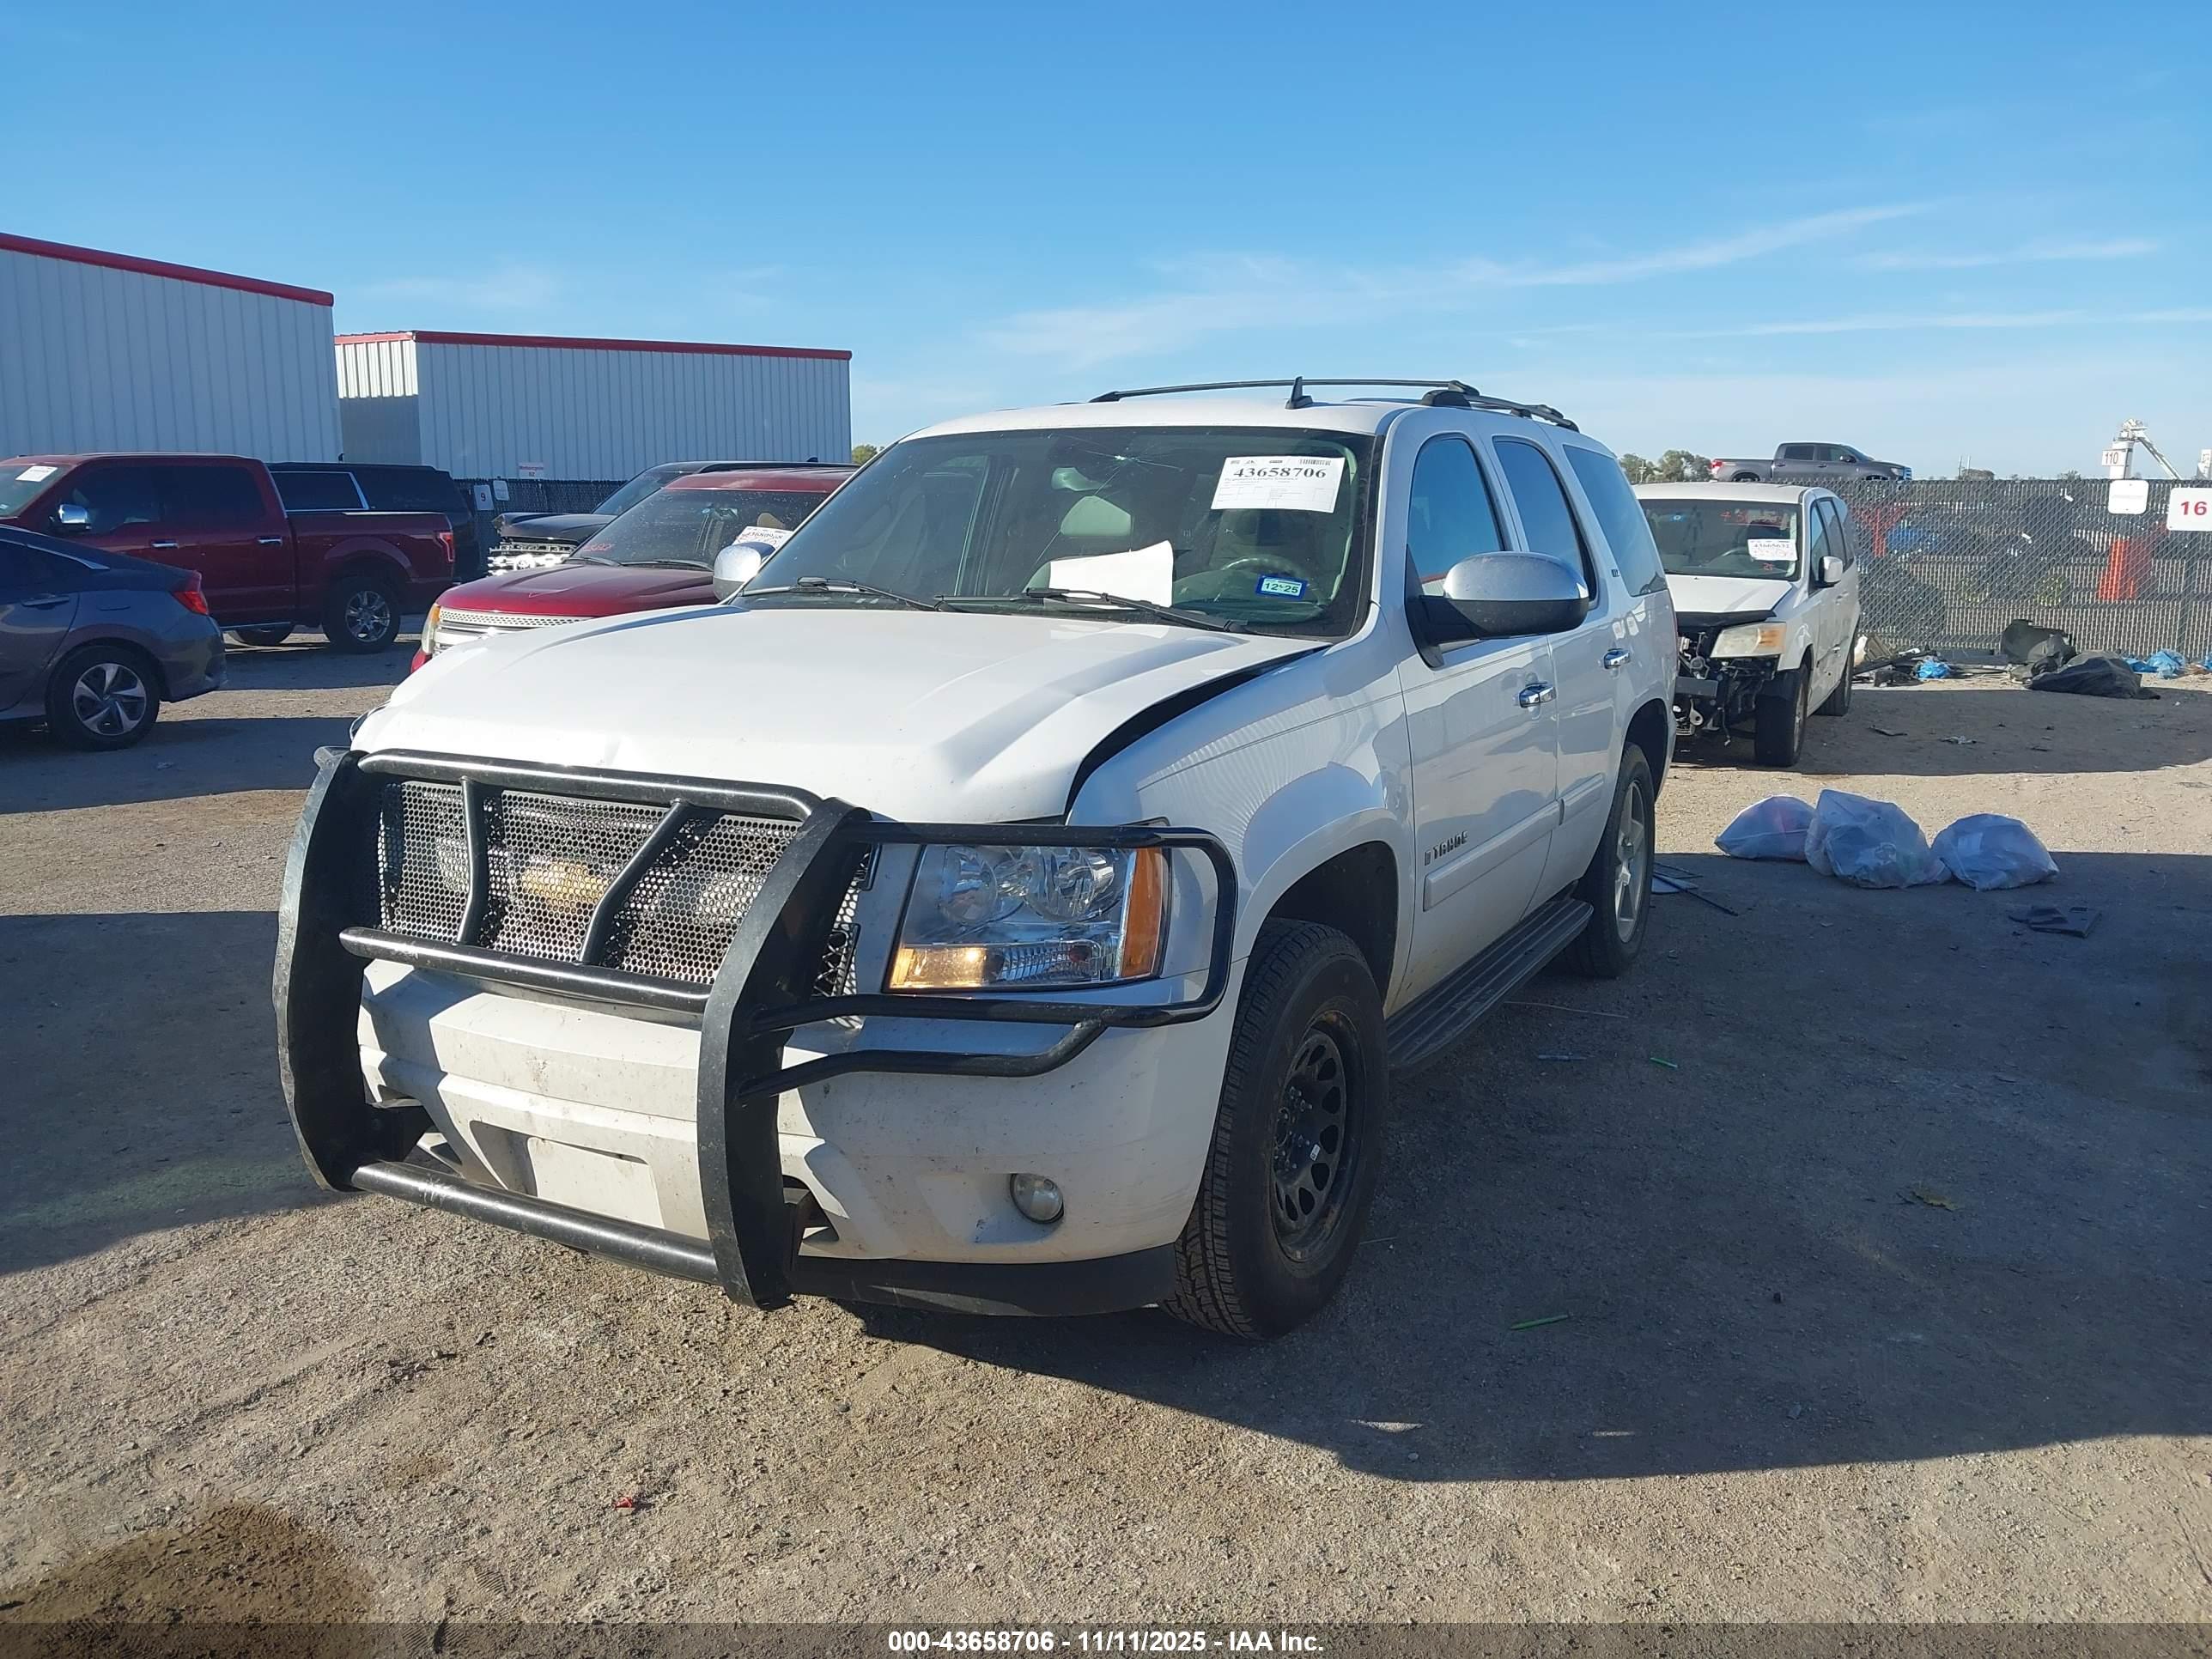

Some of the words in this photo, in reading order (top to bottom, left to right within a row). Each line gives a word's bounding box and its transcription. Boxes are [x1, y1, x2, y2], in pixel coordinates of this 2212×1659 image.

[2105, 452, 2119, 465] 110
[1233, 467, 1327, 478] 43658706
[2180, 501, 2208, 516] 16
[1432, 830, 1468, 860] TAHOE
